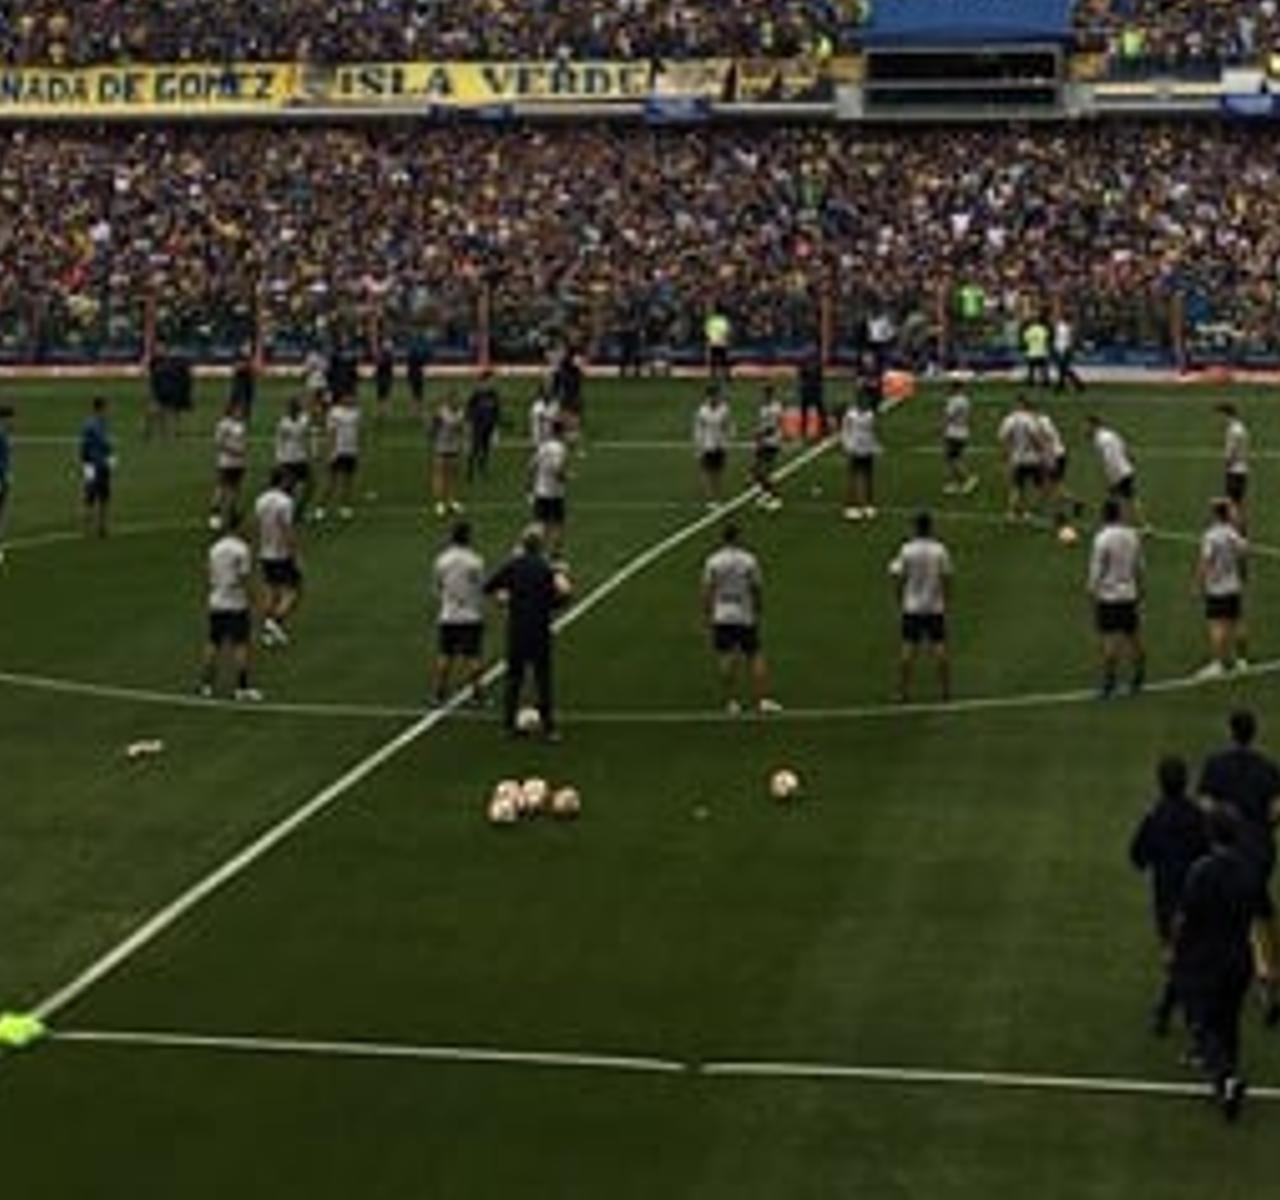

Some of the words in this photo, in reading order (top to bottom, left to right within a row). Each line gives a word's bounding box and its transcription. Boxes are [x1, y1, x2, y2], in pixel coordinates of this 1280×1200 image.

[98, 70, 147, 102] DE
[154, 69, 272, 101] GOMEZ
[341, 67, 453, 96] ISLA
[483, 65, 646, 97] VERDE
